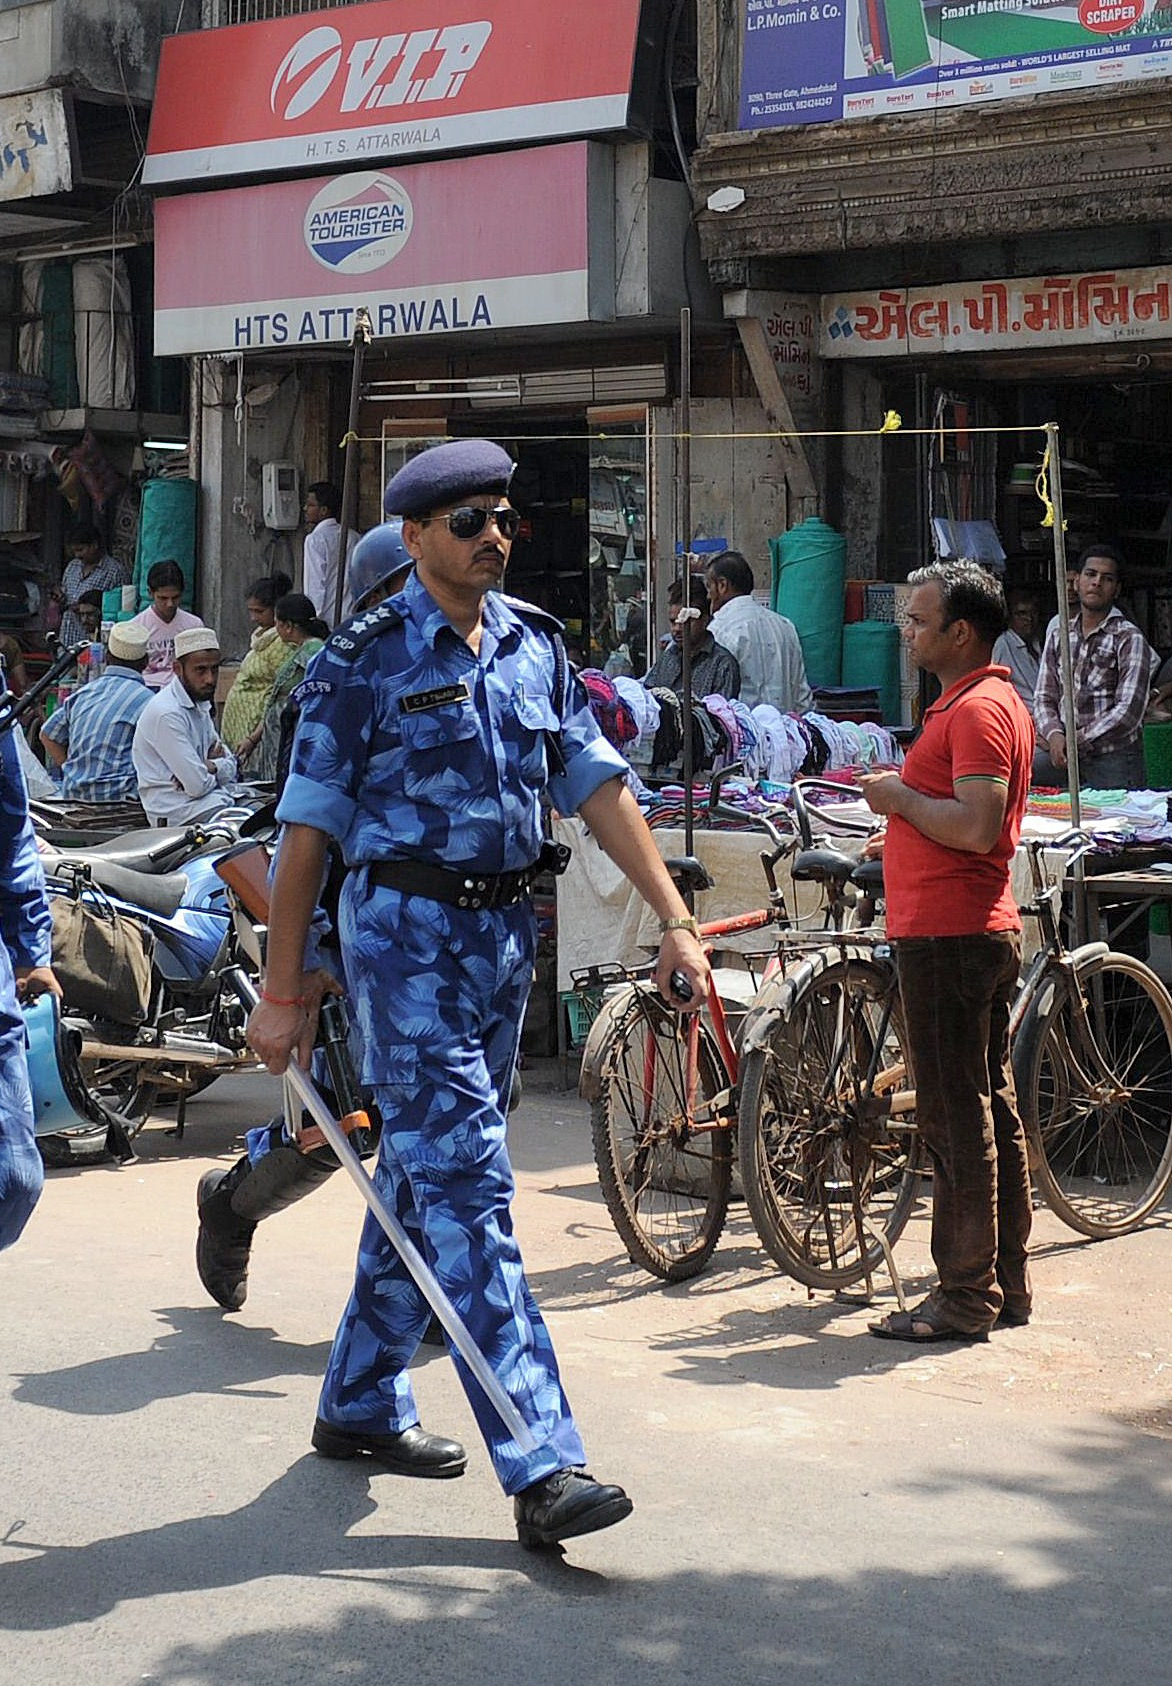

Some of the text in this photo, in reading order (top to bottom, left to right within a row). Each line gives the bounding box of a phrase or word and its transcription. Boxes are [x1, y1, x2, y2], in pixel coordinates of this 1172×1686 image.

[810, 6, 820, 20] &
[822, 4, 841, 19] Co.
[941, 5, 976, 20] Smart
[977, 0, 1023, 15] Matting
[1086, 5, 1136, 25] SCRAPER
[960, 65, 984, 76] million
[1021, 54, 1053, 67] WORLD'S
[1053, 49, 1085, 61] LARGEST
[1085, 45, 1115, 57] SELLING
[306, 128, 441, 157] H. T. S. ATTARWALA
[310, 203, 405, 227] AMERICAN
[309, 218, 405, 241] TOURISTER
[235, 295, 493, 347] HTS ATTRWALA
